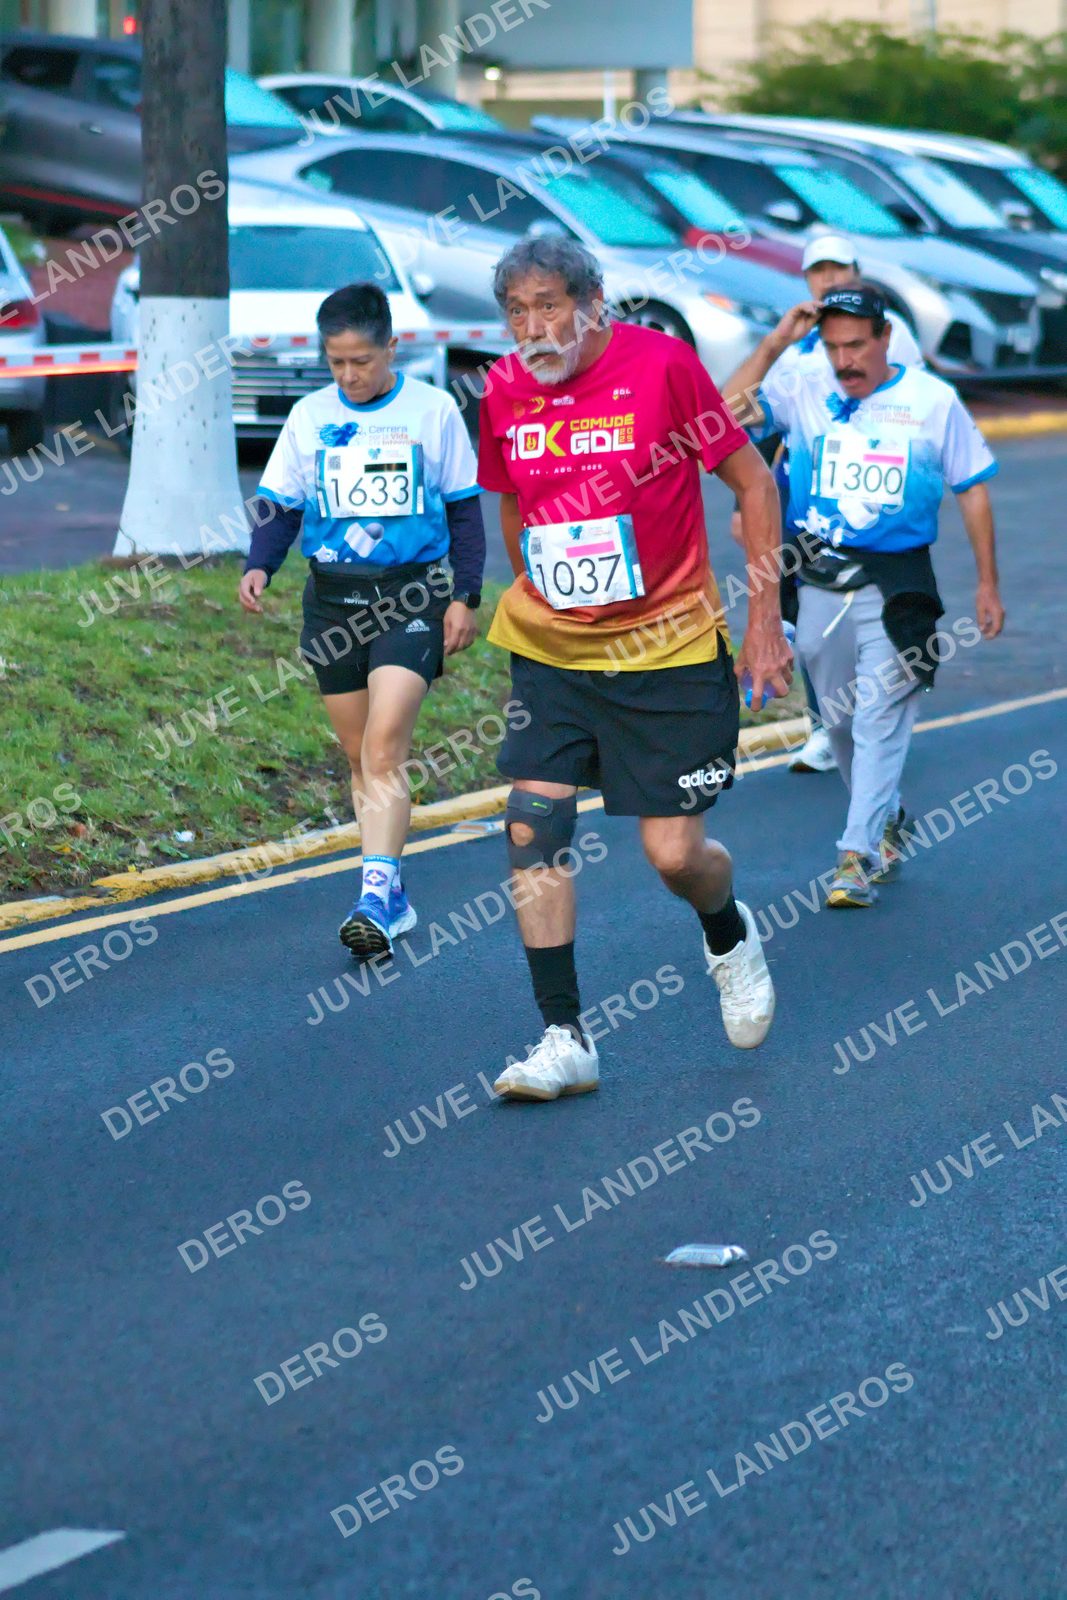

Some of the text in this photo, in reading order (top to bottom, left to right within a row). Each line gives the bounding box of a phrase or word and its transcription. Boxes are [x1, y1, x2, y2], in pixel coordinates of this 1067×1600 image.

[570, 413, 635, 431] COMUDE
[506, 420, 567, 461] 10K
[570, 428, 636, 456] GDL
[331, 474, 410, 508] 1633
[828, 460, 904, 496] 1300
[536, 552, 622, 599] 1037
[677, 767, 731, 789] adida
